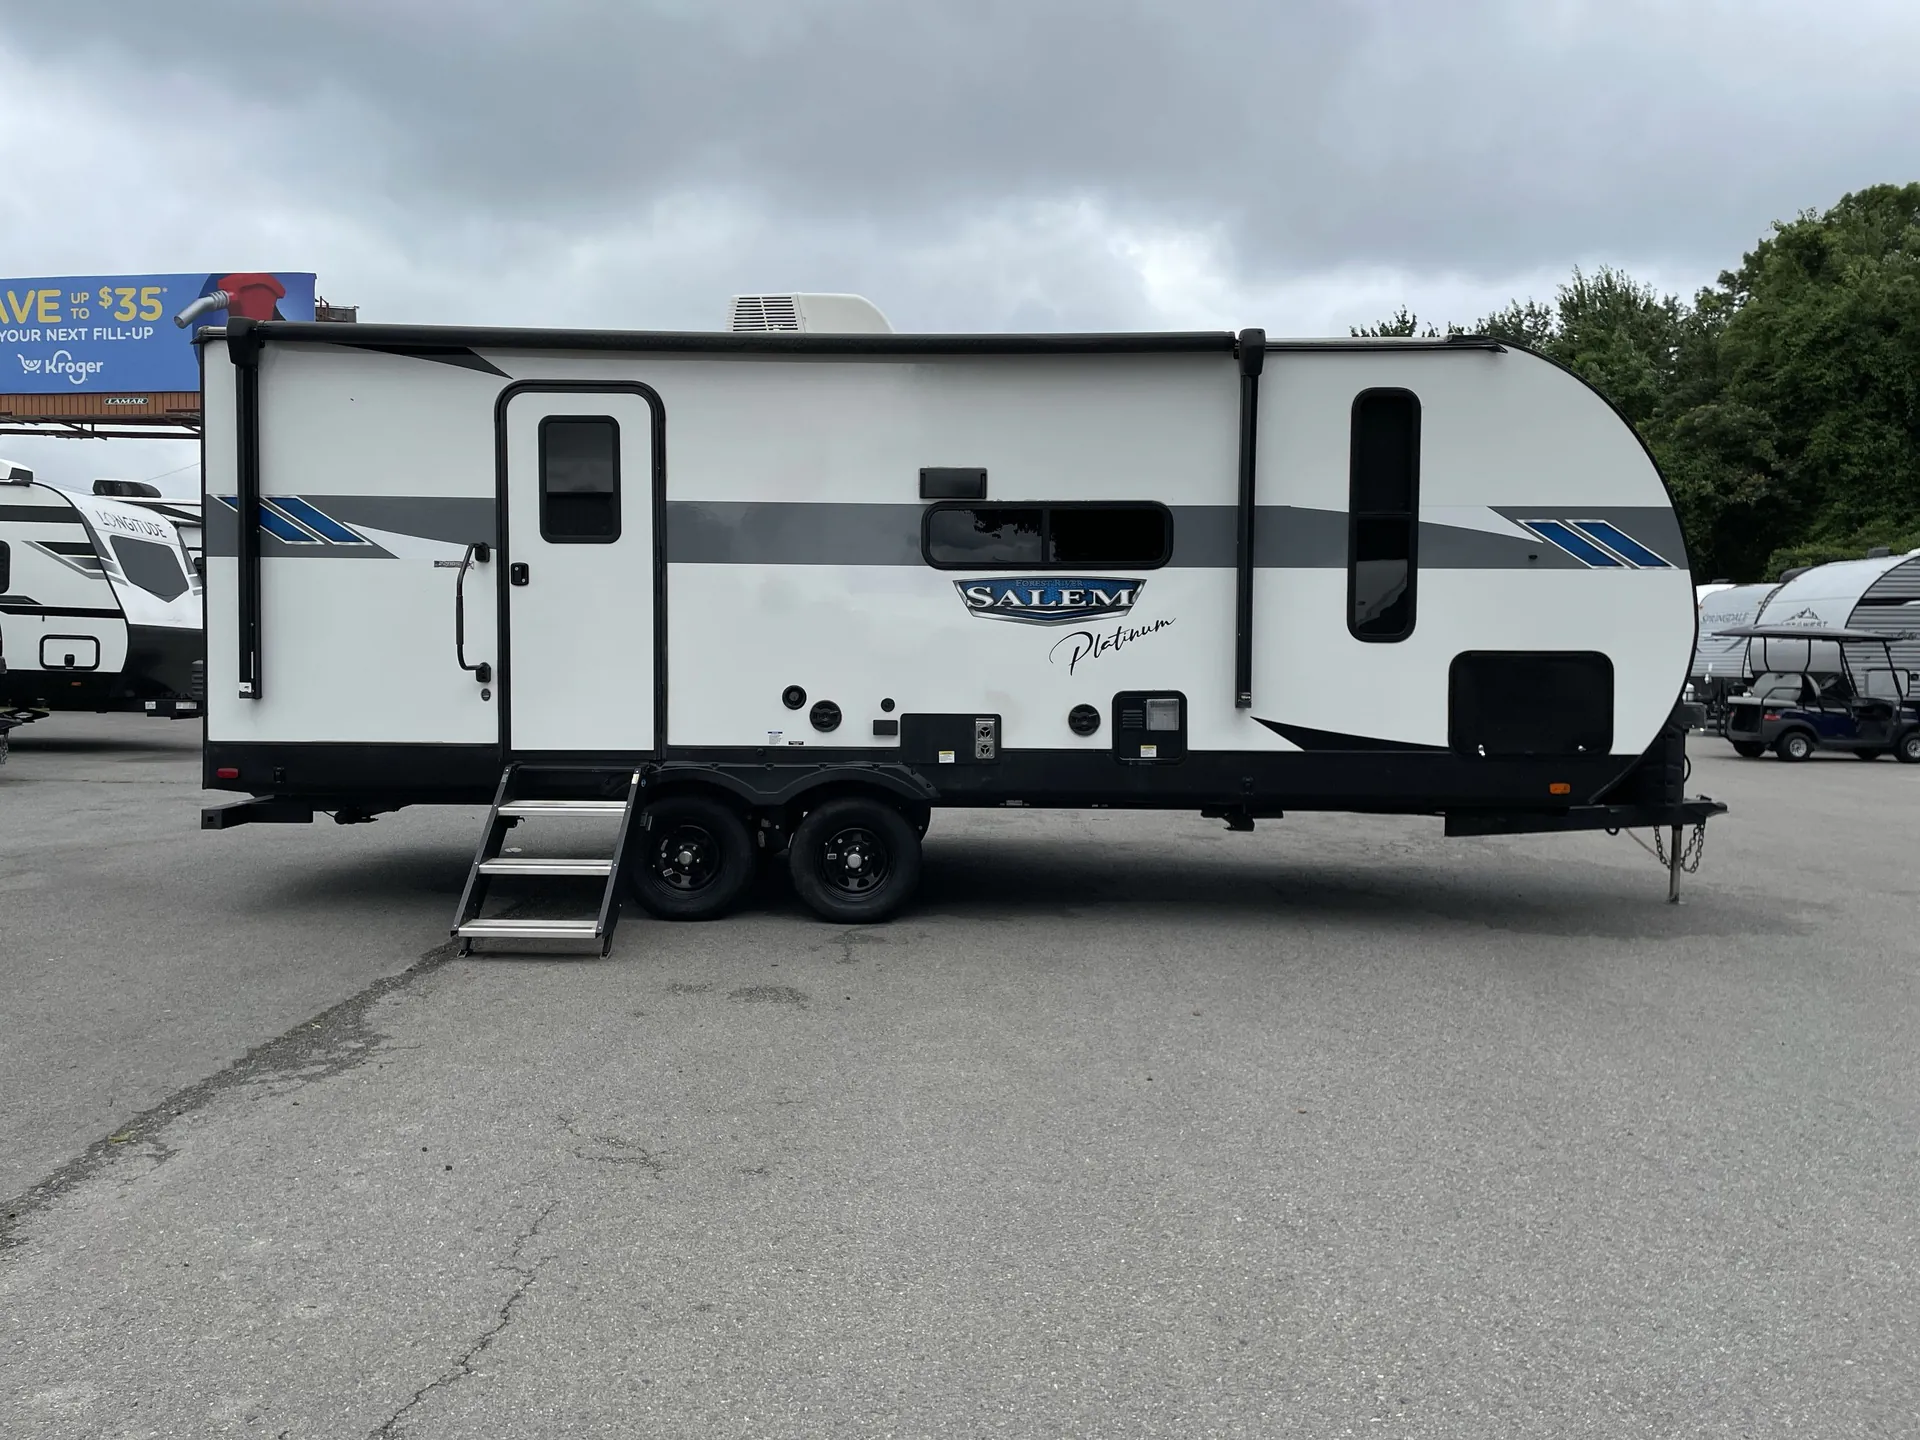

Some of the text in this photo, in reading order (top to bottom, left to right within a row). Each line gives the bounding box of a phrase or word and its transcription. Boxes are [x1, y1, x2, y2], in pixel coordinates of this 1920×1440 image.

[70, 292, 90, 304] UP
[70, 308, 90, 320] TO
[46, 328, 88, 341] NEXT
[93, 326, 154, 340] FILL-UP
[45, 350, 104, 385] Kroger
[95, 510, 167, 538] LONGITUDE
[965, 586, 1134, 608] SALEM
[1049, 617, 1177, 676] Platinum
